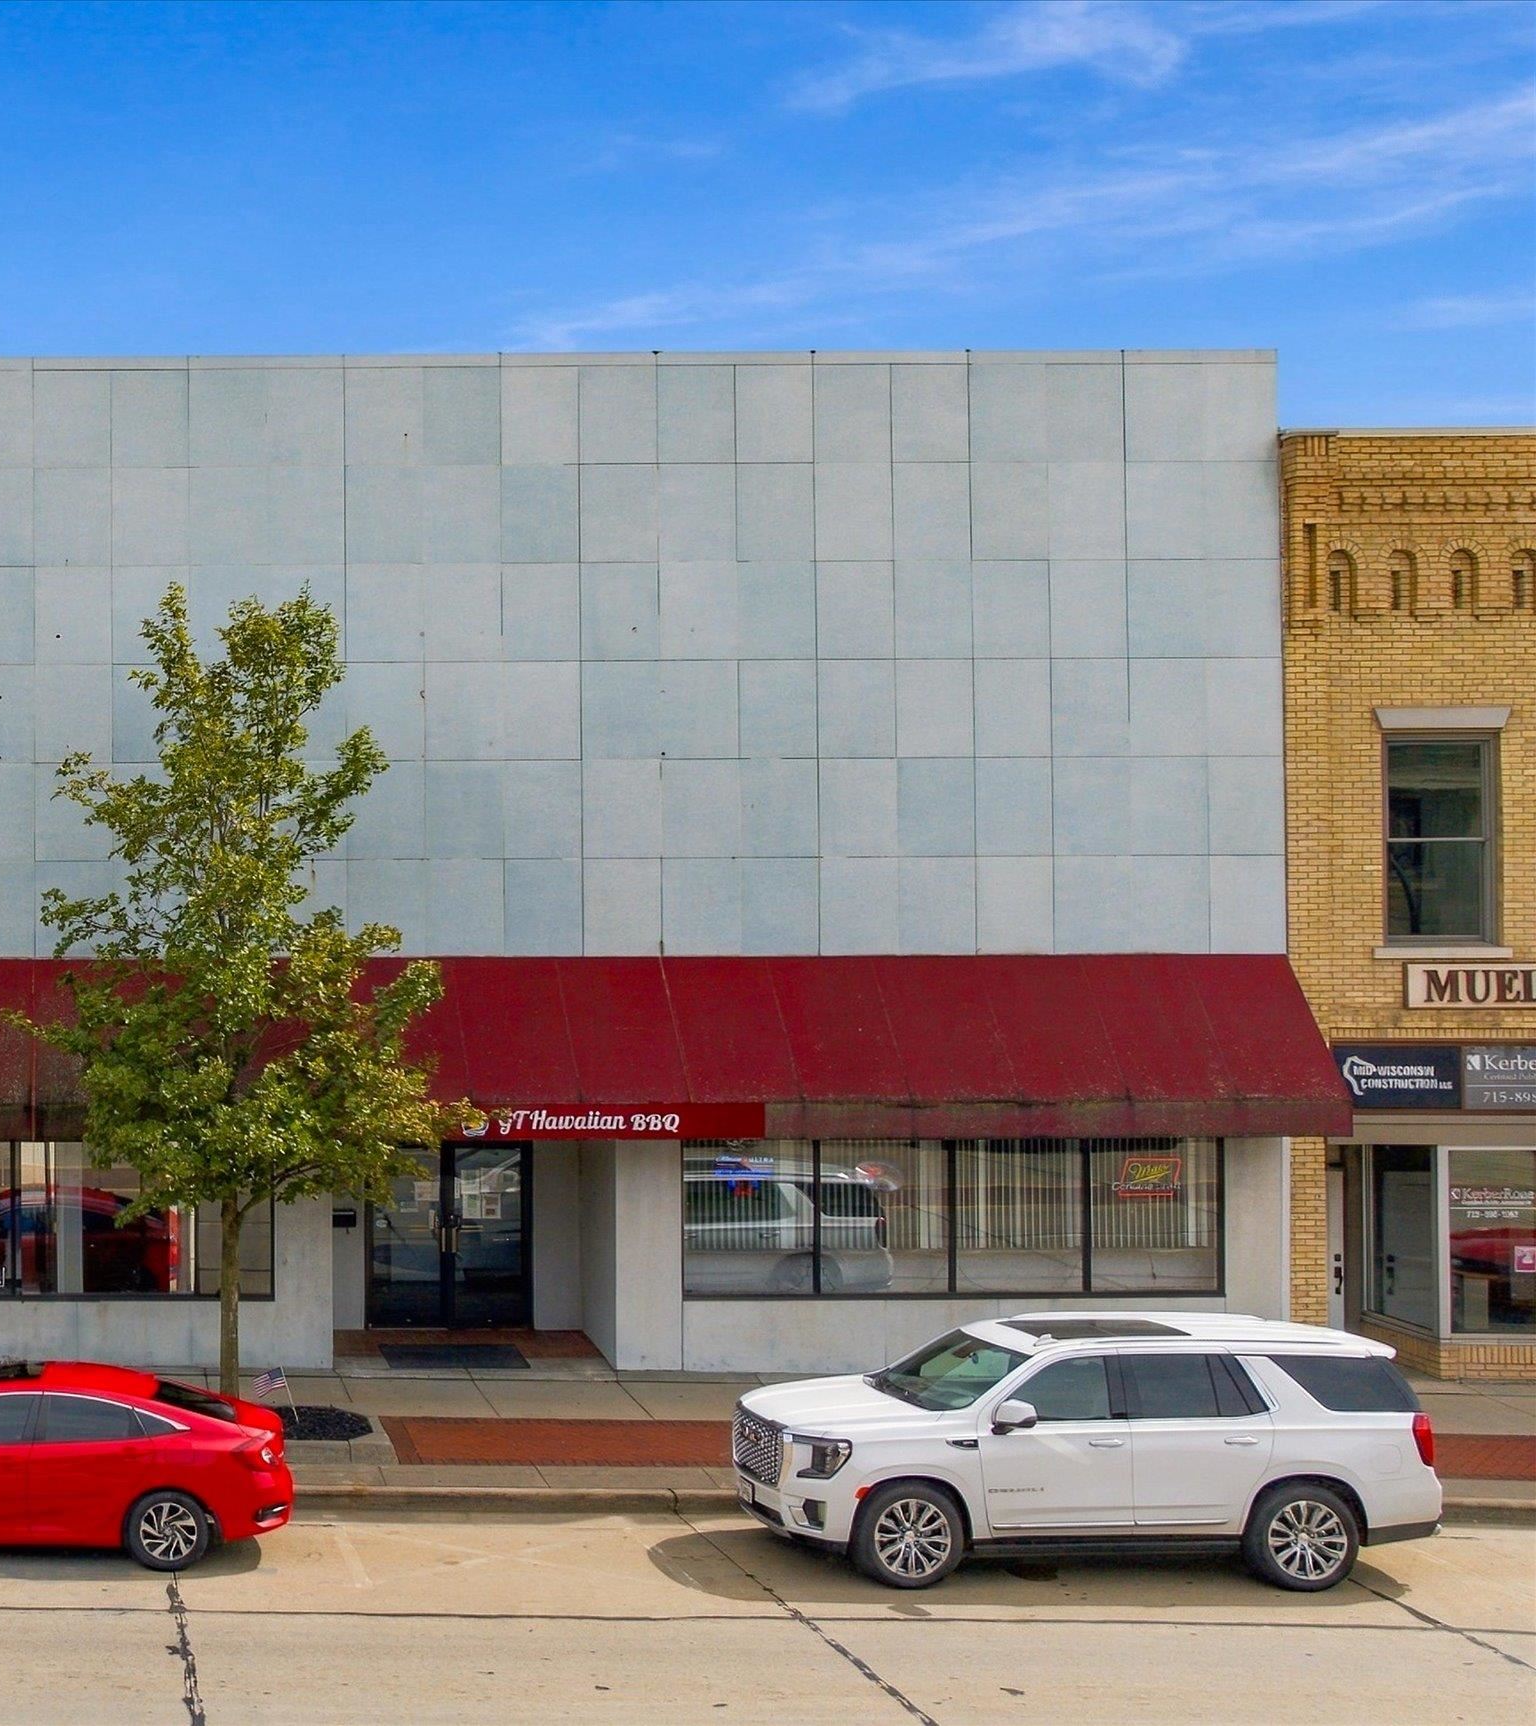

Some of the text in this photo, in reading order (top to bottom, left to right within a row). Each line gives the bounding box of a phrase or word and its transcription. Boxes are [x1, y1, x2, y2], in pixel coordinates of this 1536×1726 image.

[1360, 1078, 1439, 1090] CONSTRUCTION
[529, 1110, 626, 1130] Hawaiian
[630, 1113, 680, 1133] BBQ
